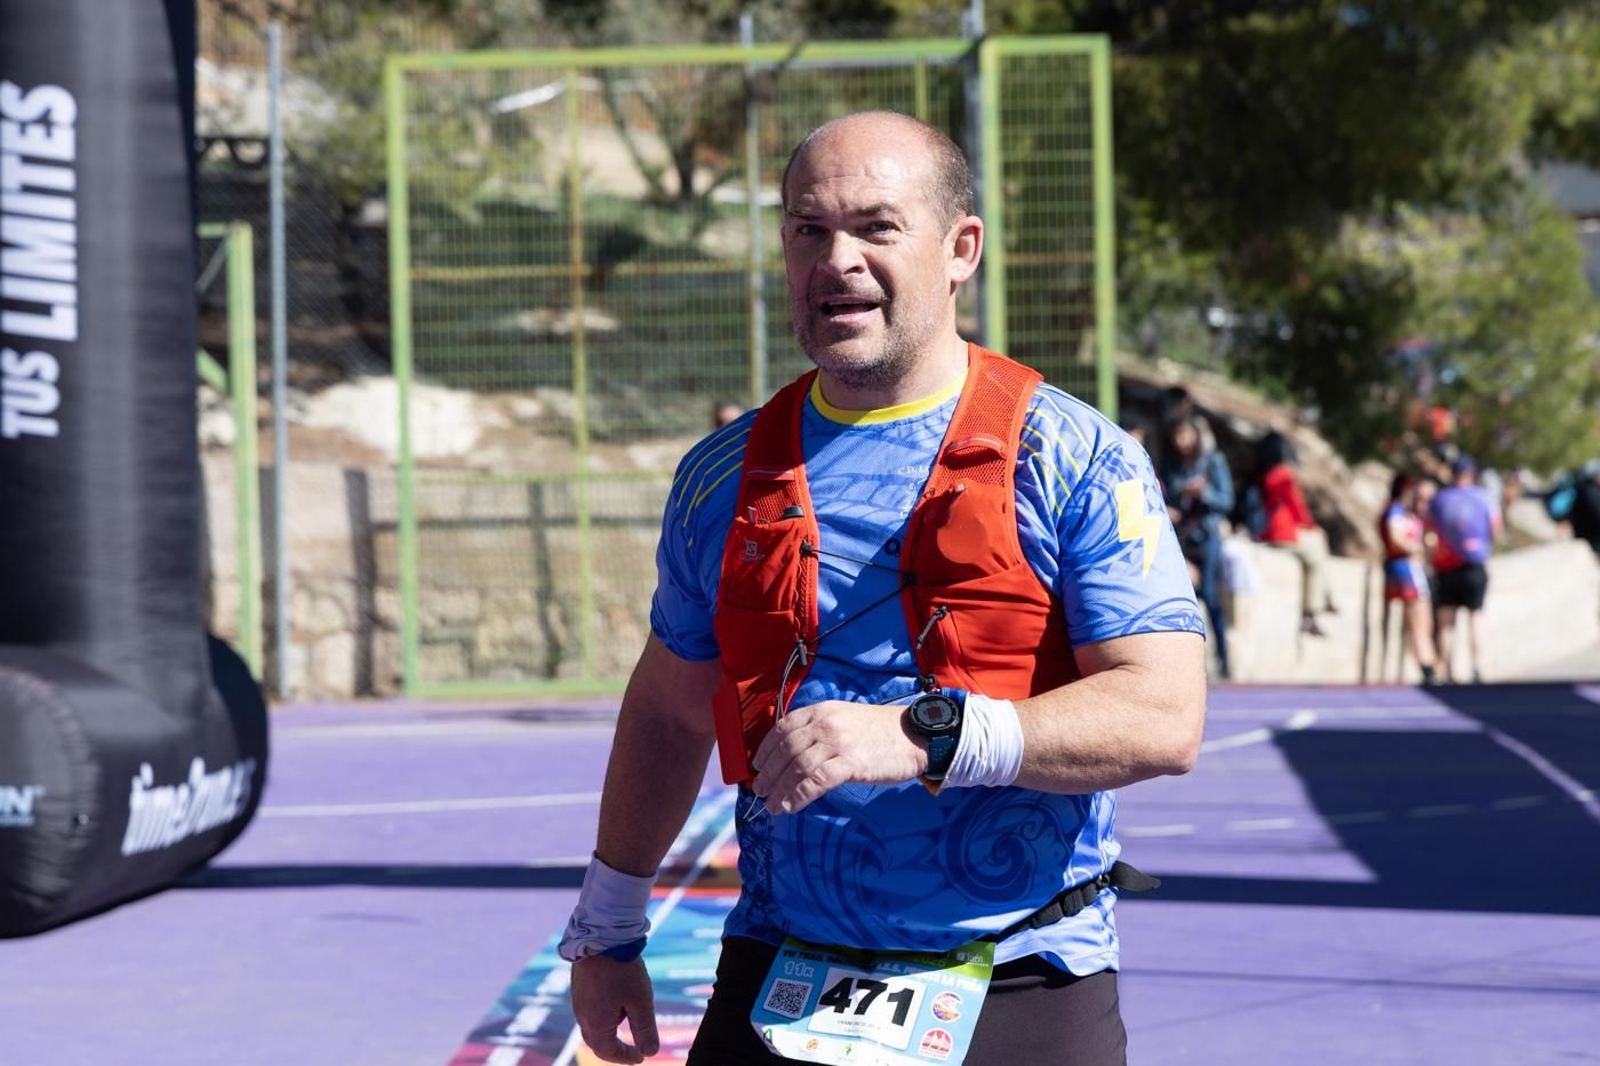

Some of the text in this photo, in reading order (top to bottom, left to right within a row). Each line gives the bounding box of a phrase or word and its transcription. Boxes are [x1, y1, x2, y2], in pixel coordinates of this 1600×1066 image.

[0, 80, 77, 438] TUS LIMITES
[818, 977, 915, 1027] 471
